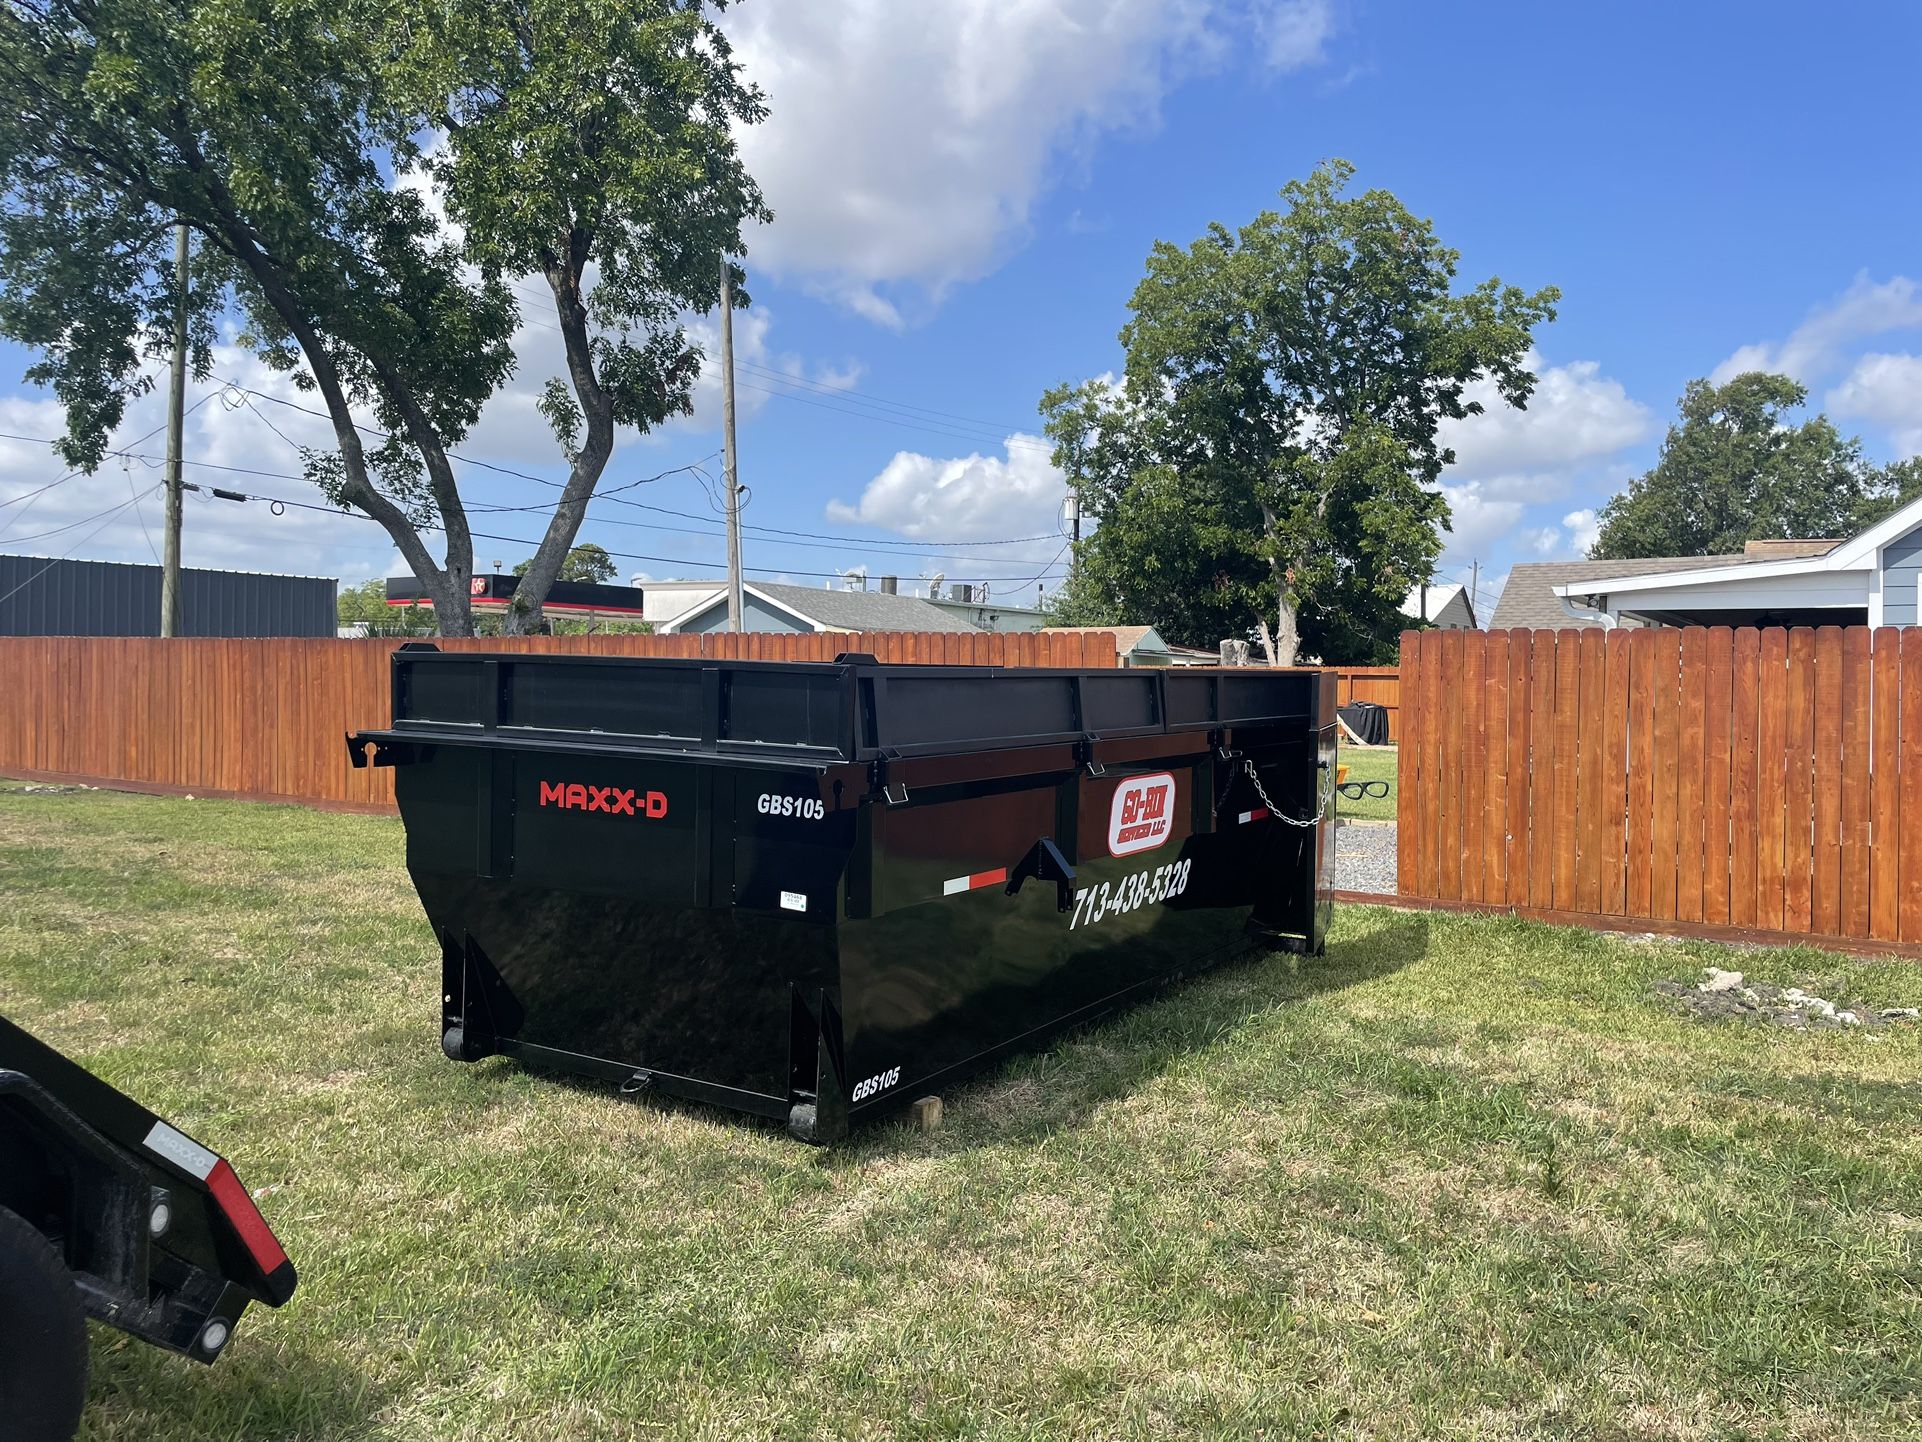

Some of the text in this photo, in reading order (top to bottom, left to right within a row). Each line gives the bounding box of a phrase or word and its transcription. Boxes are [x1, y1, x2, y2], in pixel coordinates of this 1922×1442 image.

[540, 781, 668, 819] MAXX-D
[757, 793, 825, 820] GBS105
[1069, 858, 1192, 931] 713-438-5328
[852, 1066, 901, 1102] GBS105
